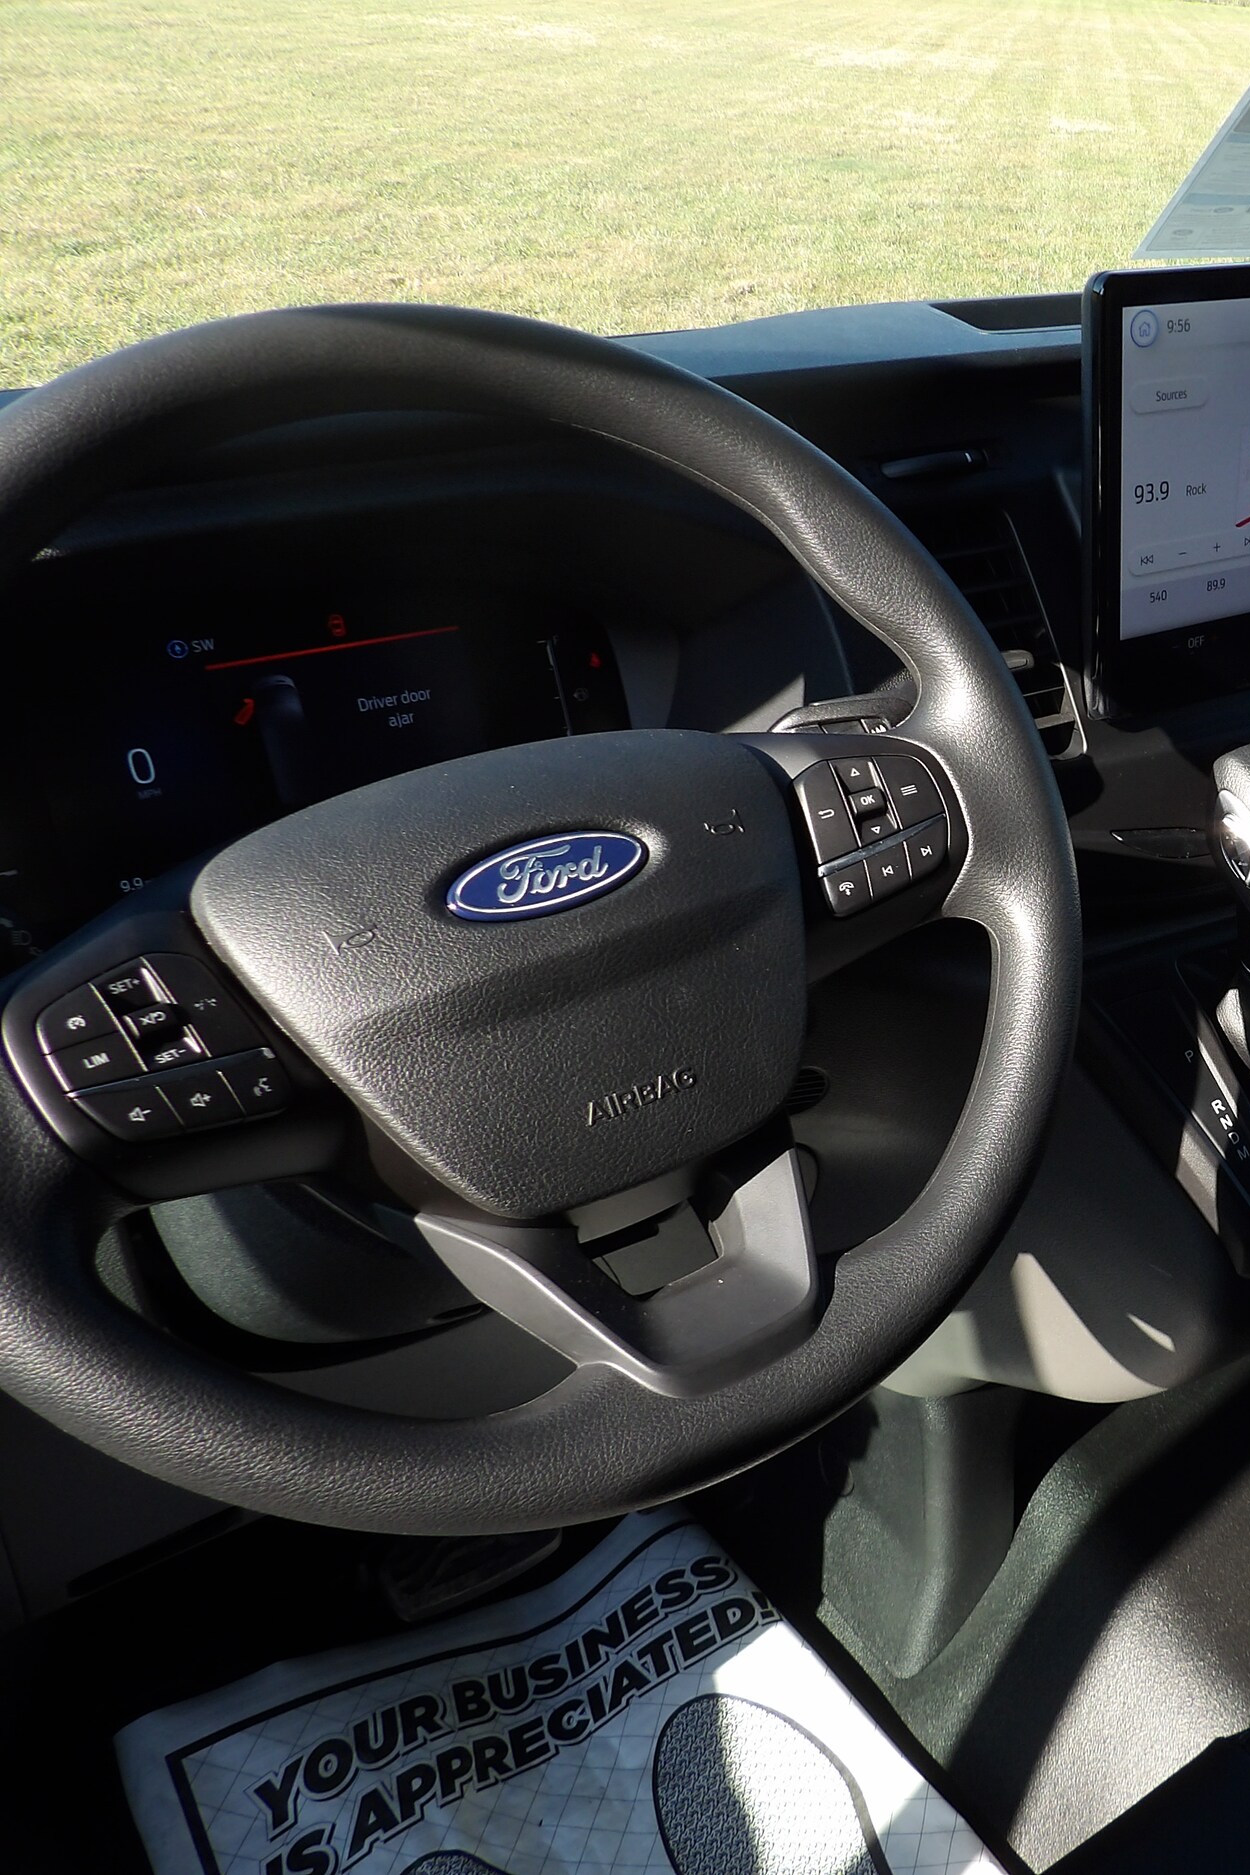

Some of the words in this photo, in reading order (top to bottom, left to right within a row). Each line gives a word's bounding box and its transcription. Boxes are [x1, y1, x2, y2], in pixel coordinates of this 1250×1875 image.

[1167, 319, 1191, 333] 9:56
[1156, 389, 1188, 402] Sources
[1134, 480, 1170, 504] 93.9
[1185, 483, 1207, 497] Rock
[1150, 589, 1167, 603] 540
[1207, 578, 1226, 592] 89.9
[191, 638, 215, 654] SW
[1188, 635, 1205, 649] OFF
[357, 694, 397, 713] Driver
[401, 687, 431, 707] door
[389, 709, 414, 729] ajar
[127, 748, 156, 785] 0
[860, 794, 875, 806] OK
[497, 844, 608, 903] Ford
[109, 978, 140, 995] SET+
[83, 1052, 110, 1069] LIM
[154, 1047, 187, 1064] SET-
[1184, 1050, 1194, 1063] P
[585, 1066, 698, 1127] AIRBAG
[1211, 1099, 1226, 1115] R
[1219, 1114, 1233, 1130] N
[1228, 1132, 1240, 1145] D
[1237, 1146, 1250, 1160] M
[253, 1694, 445, 1832] YOUR
[452, 1555, 740, 1724] BUSINESS
[345, 1589, 780, 1858] APPRECIATED!
